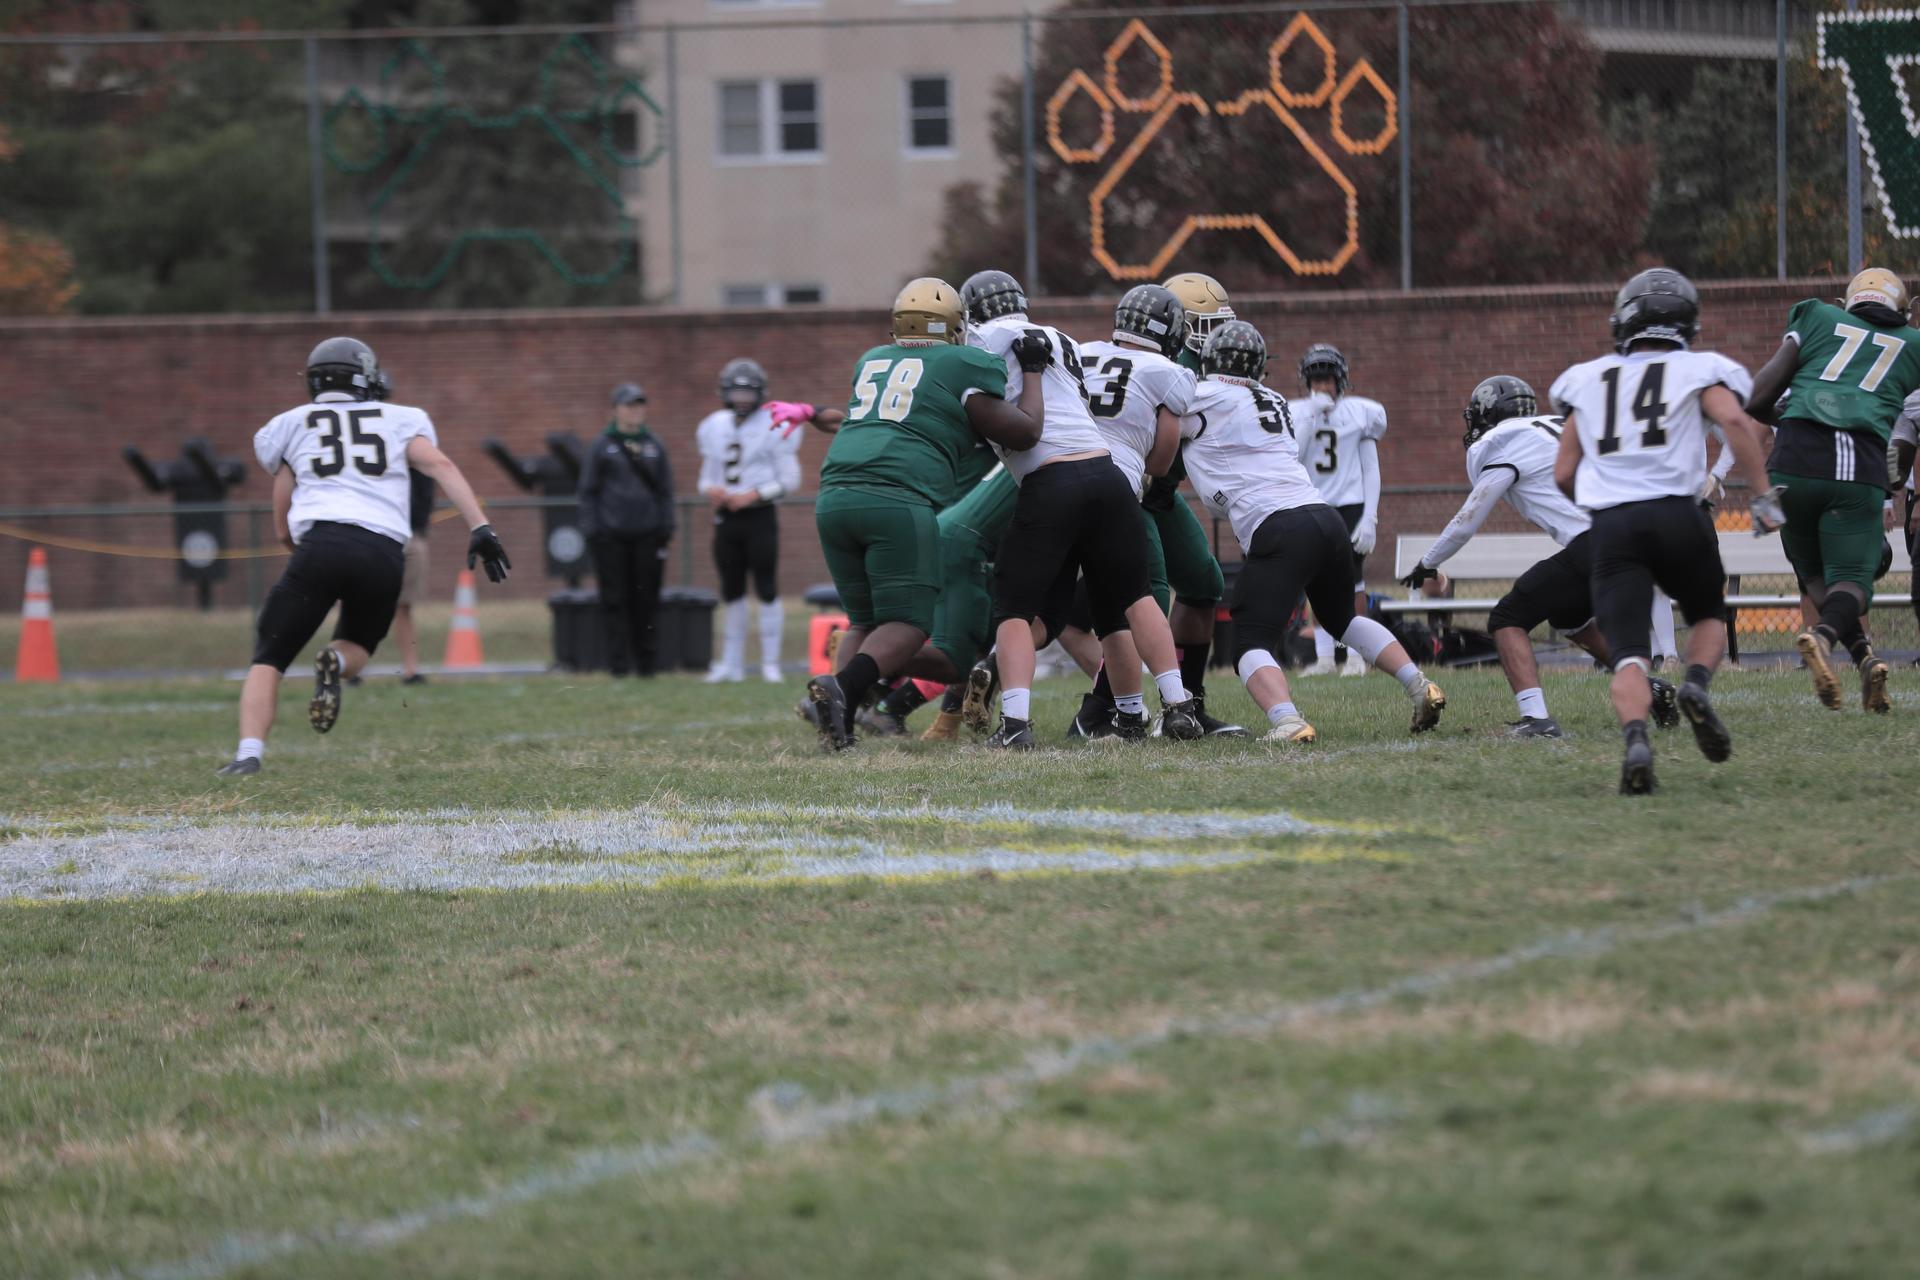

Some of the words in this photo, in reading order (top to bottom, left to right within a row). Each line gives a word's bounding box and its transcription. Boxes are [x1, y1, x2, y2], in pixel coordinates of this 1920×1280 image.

[1081, 356, 1134, 419] 3
[1818, 322, 1906, 392] 77
[849, 358, 924, 422] 58
[1597, 361, 1668, 456] 14
[305, 407, 388, 478] 35
[723, 442, 742, 485] 2
[1314, 428, 1338, 474] 3
